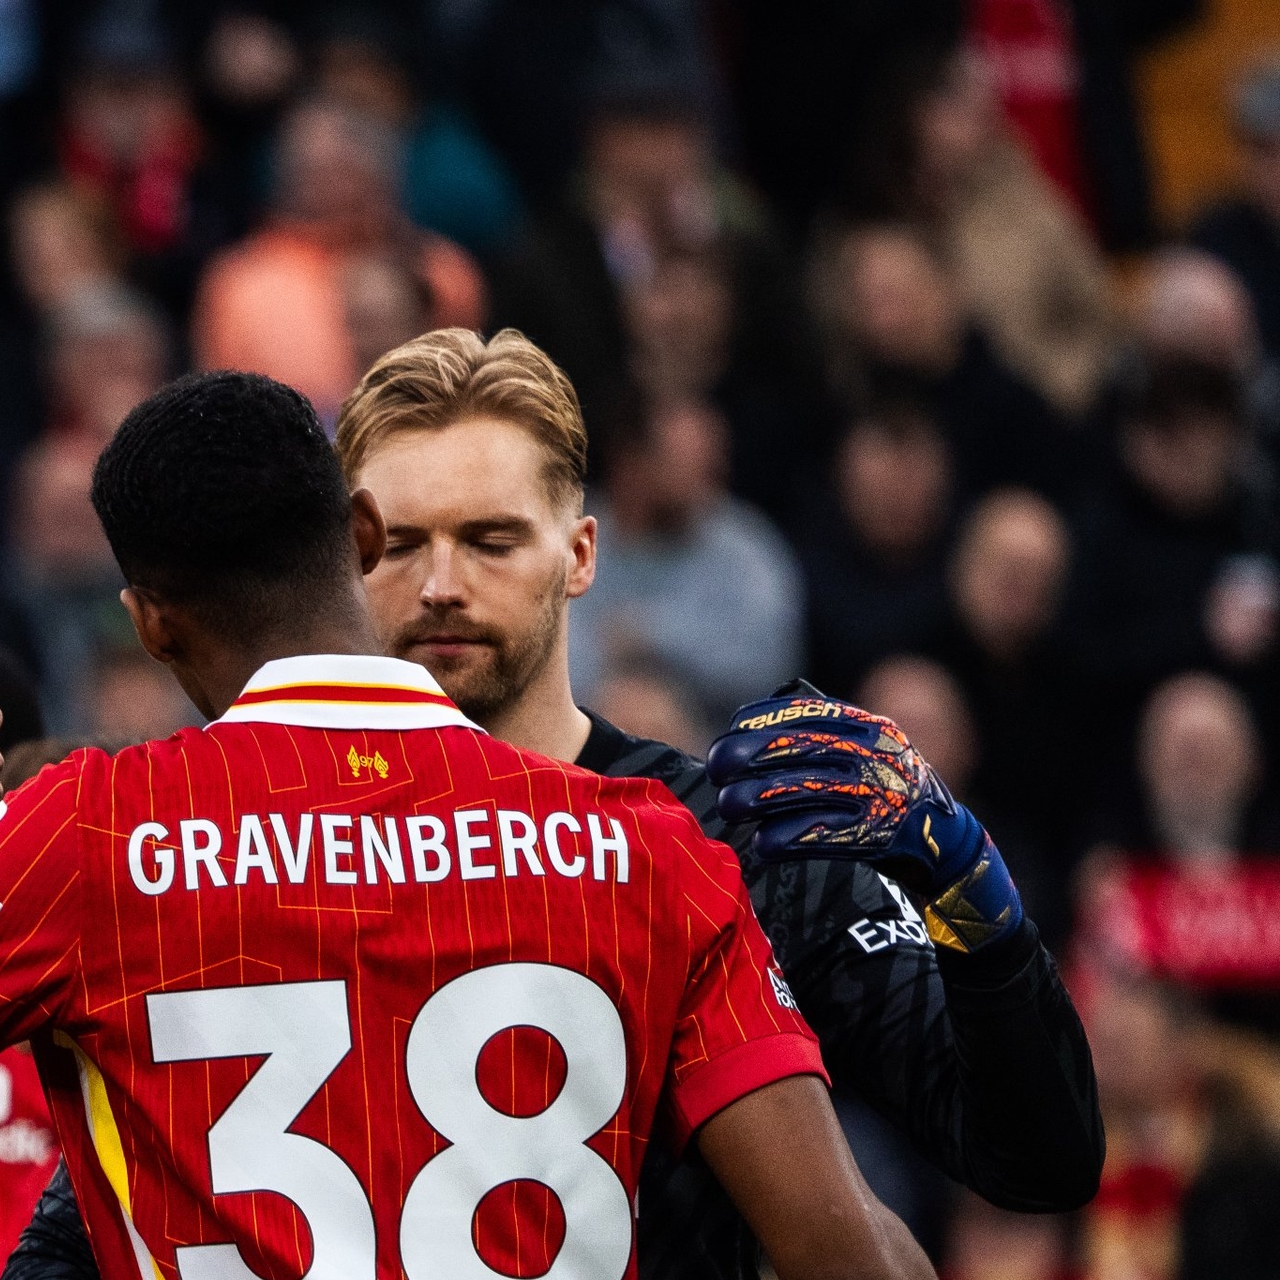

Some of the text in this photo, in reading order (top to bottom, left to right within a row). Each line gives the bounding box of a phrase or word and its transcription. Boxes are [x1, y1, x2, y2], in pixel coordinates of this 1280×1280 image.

[738, 702, 842, 730] reusch
[126, 808, 631, 897] GRAVENBERCH
[847, 918, 935, 953] Exp
